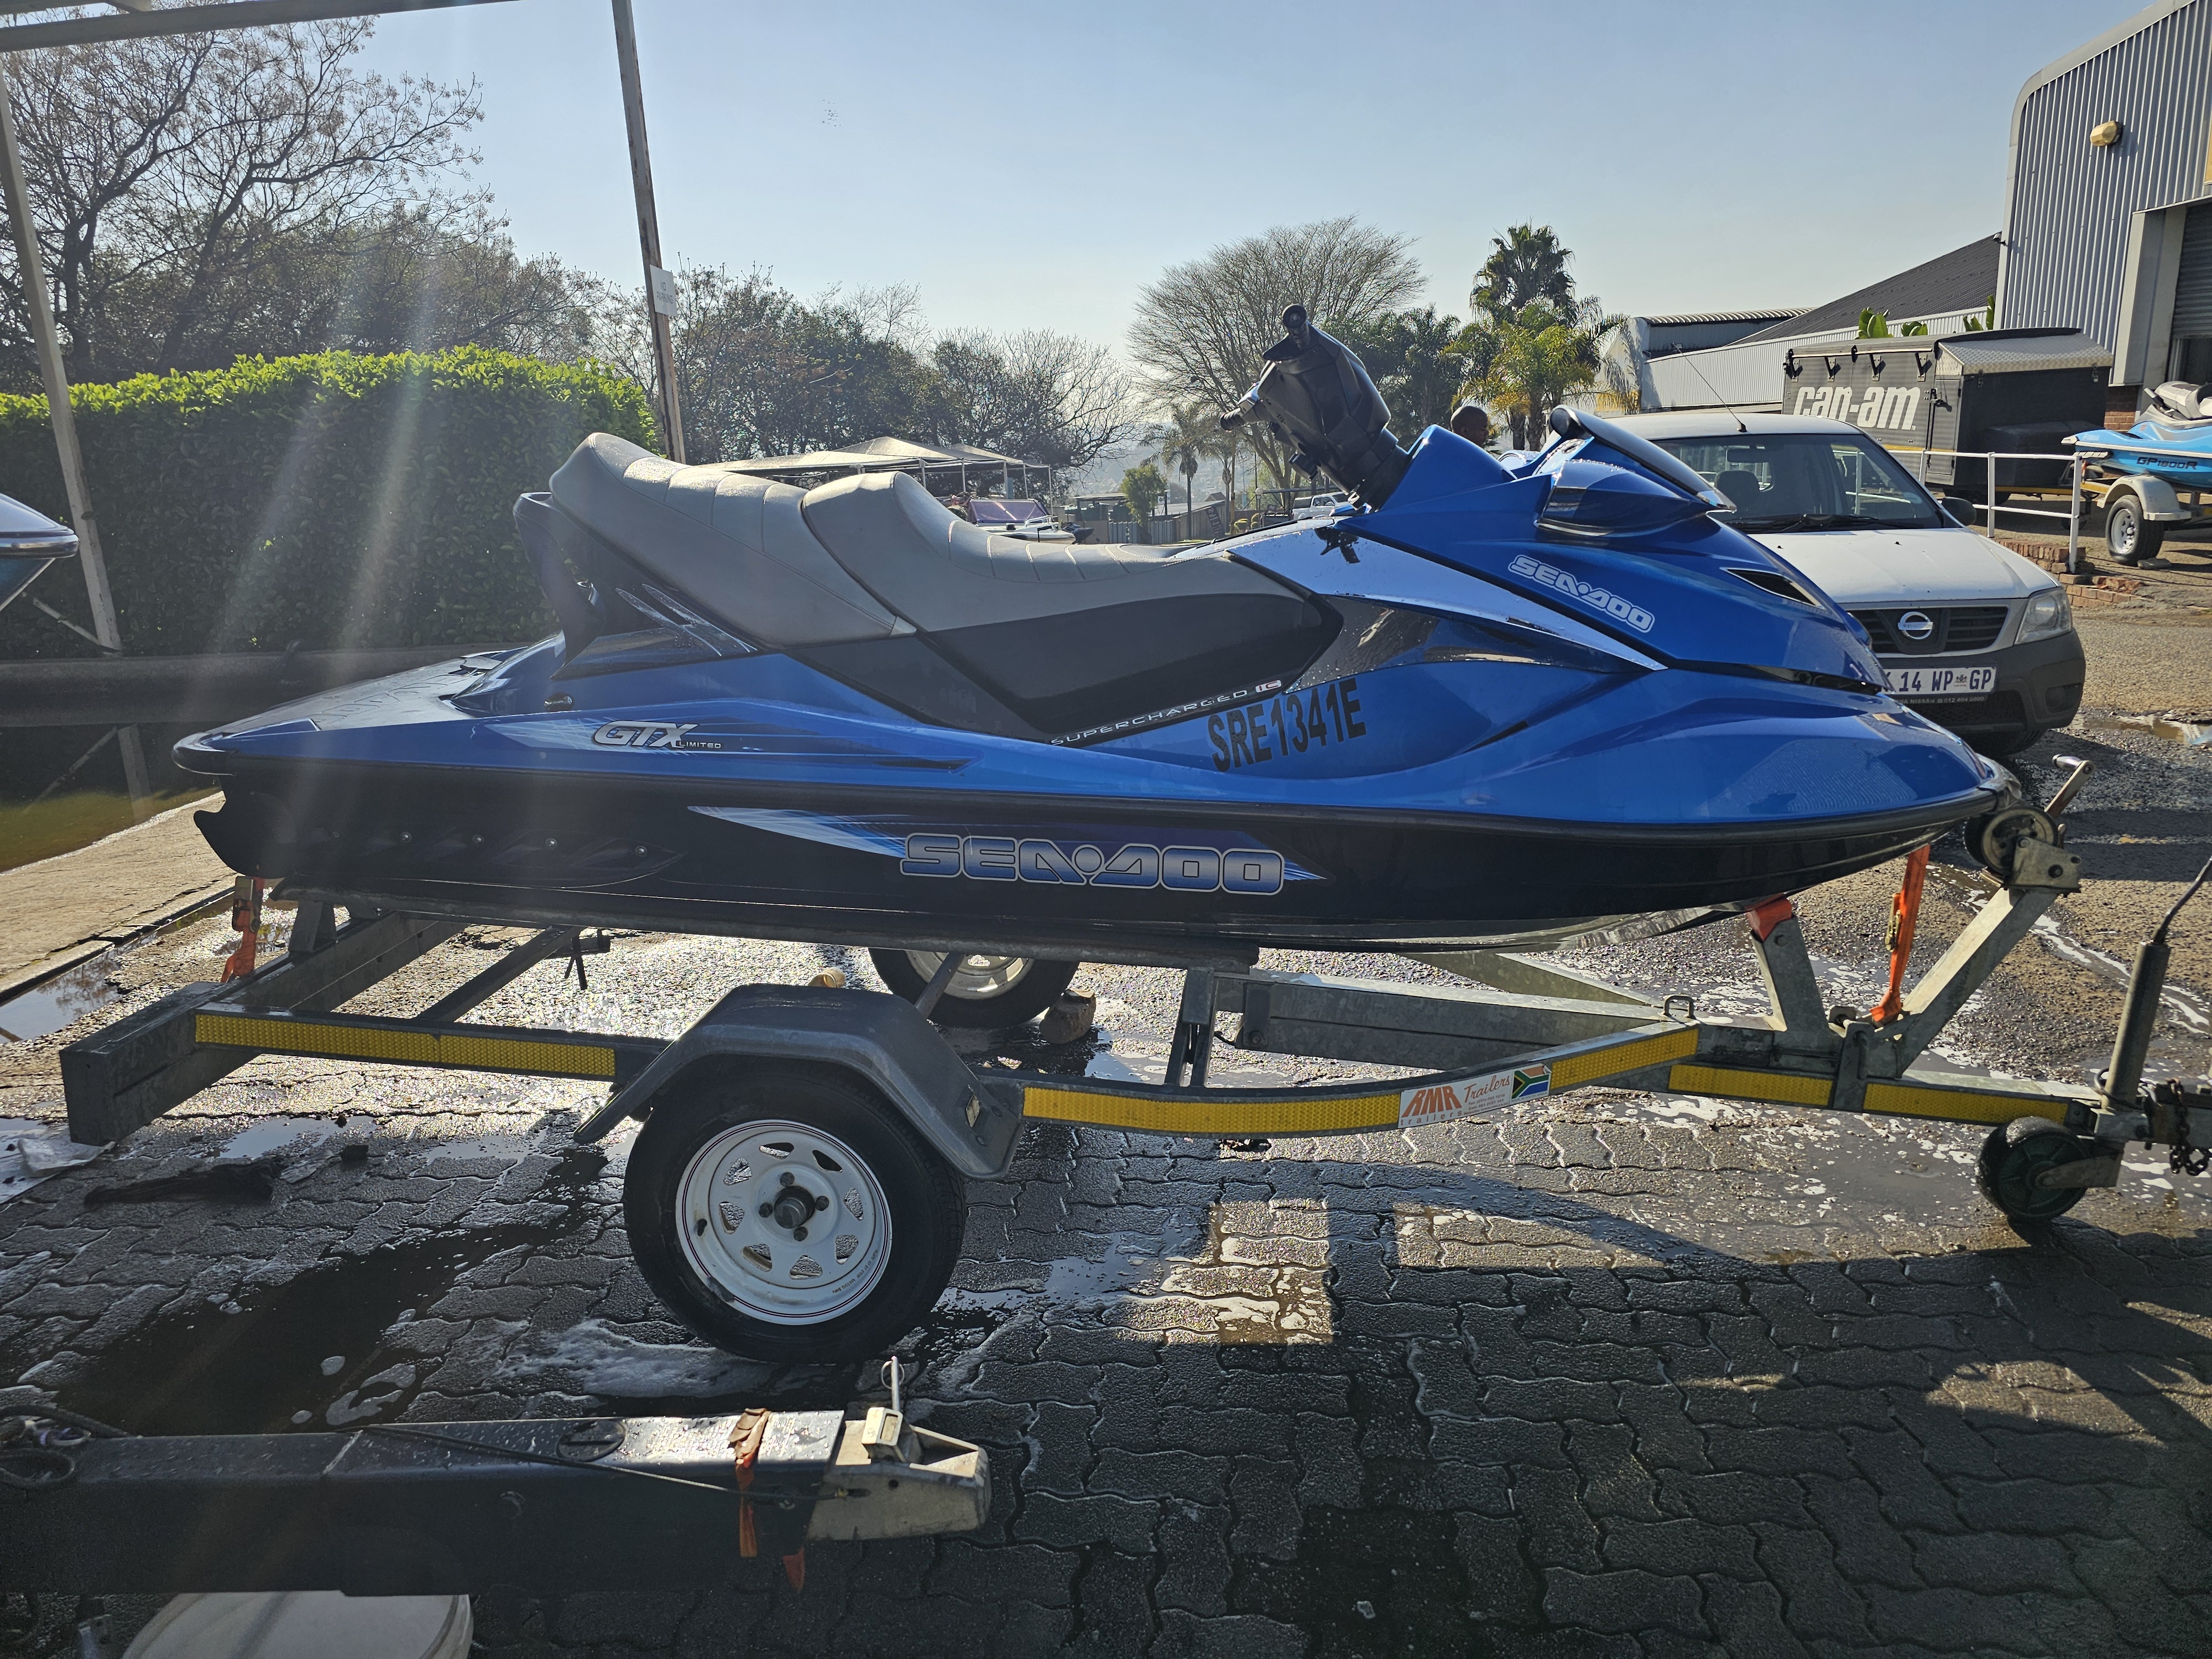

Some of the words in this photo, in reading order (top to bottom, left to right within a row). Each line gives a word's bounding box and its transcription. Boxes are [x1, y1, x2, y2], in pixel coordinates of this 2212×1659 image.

[656, 291, 673, 304] PARKING
[1793, 387, 1921, 430] can-am
[2137, 457, 2198, 469] GP1800R
[1899, 671, 1922, 692] 14
[1932, 670, 1954, 691] WP
[1969, 669, 1992, 690] GP
[1051, 690, 1247, 745] SUPERCHARGED
[1257, 680, 1281, 692] IC
[1208, 677, 1367, 773] SRE1341E
[594, 720, 698, 748] GTX
[1401, 1086, 1462, 1118] RMR
[1464, 1074, 1510, 1103] Trailers
